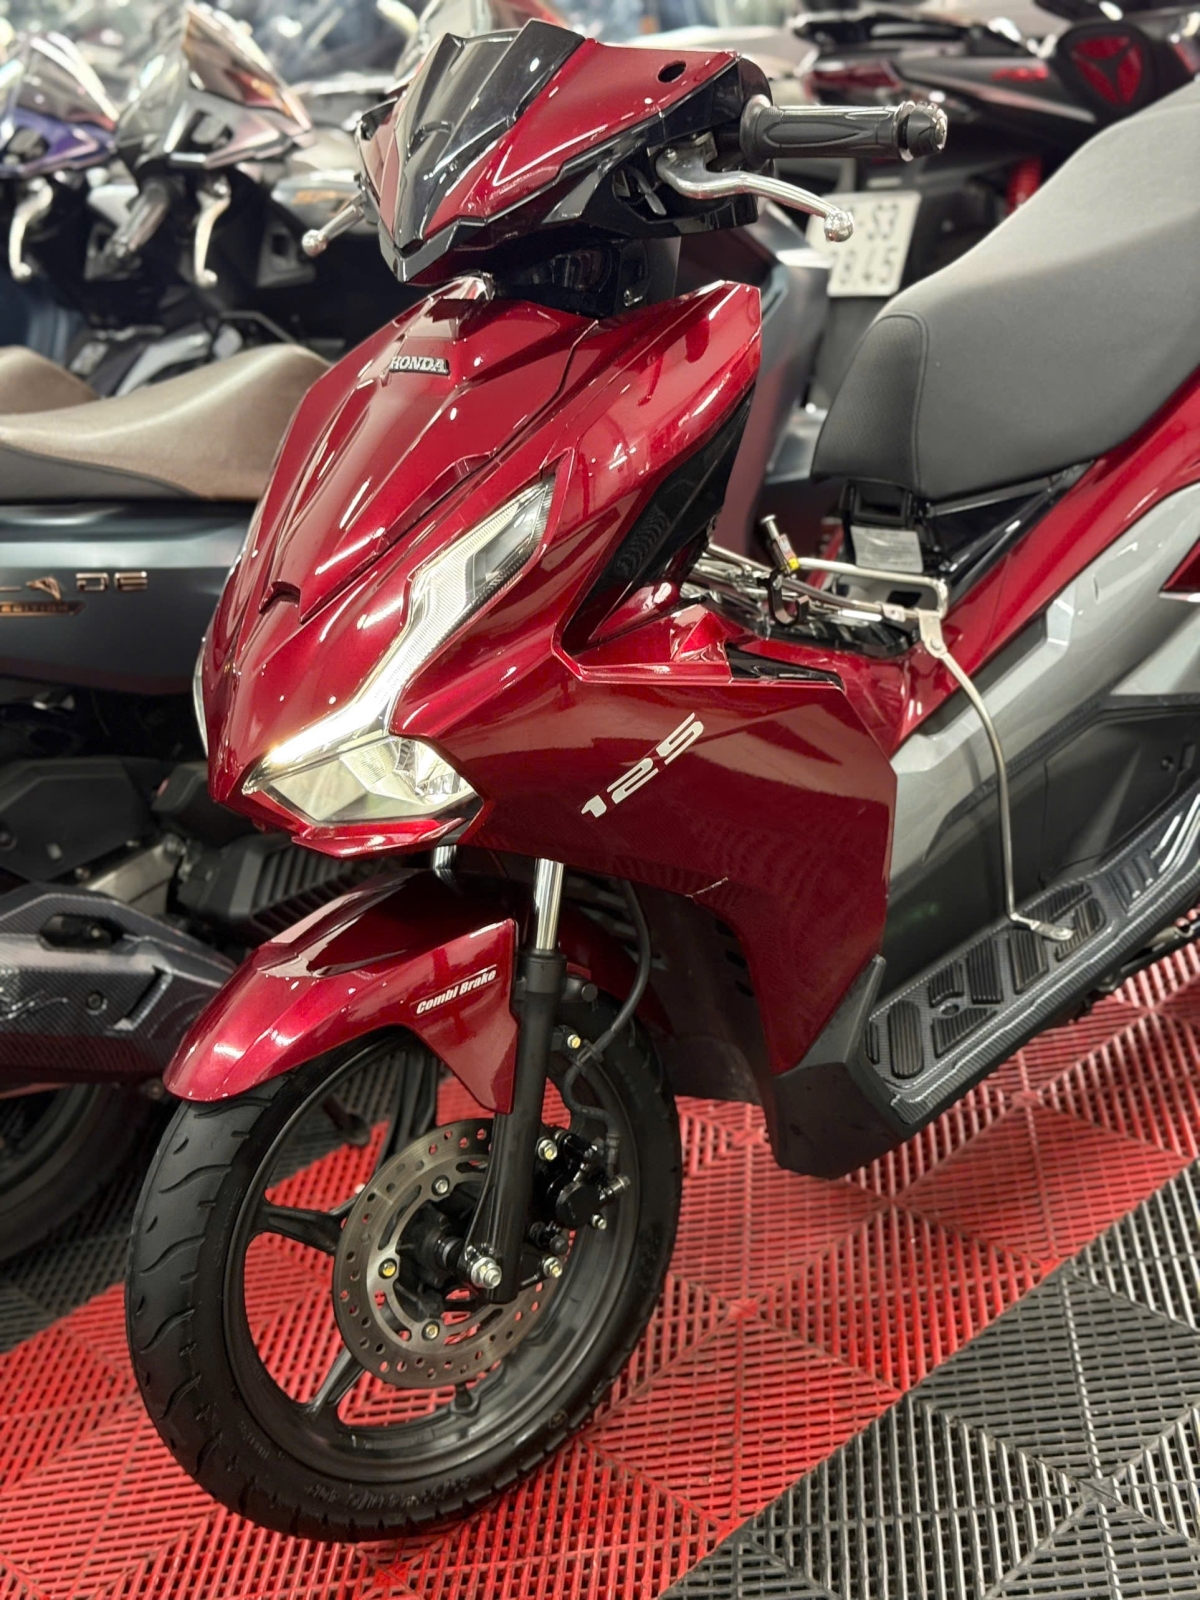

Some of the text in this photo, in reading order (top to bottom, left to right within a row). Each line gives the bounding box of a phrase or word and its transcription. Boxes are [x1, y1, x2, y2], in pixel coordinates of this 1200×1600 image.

[389, 355, 449, 373] HONDA
[580, 711, 705, 818] 125
[415, 969, 497, 1015] Combi Brake
